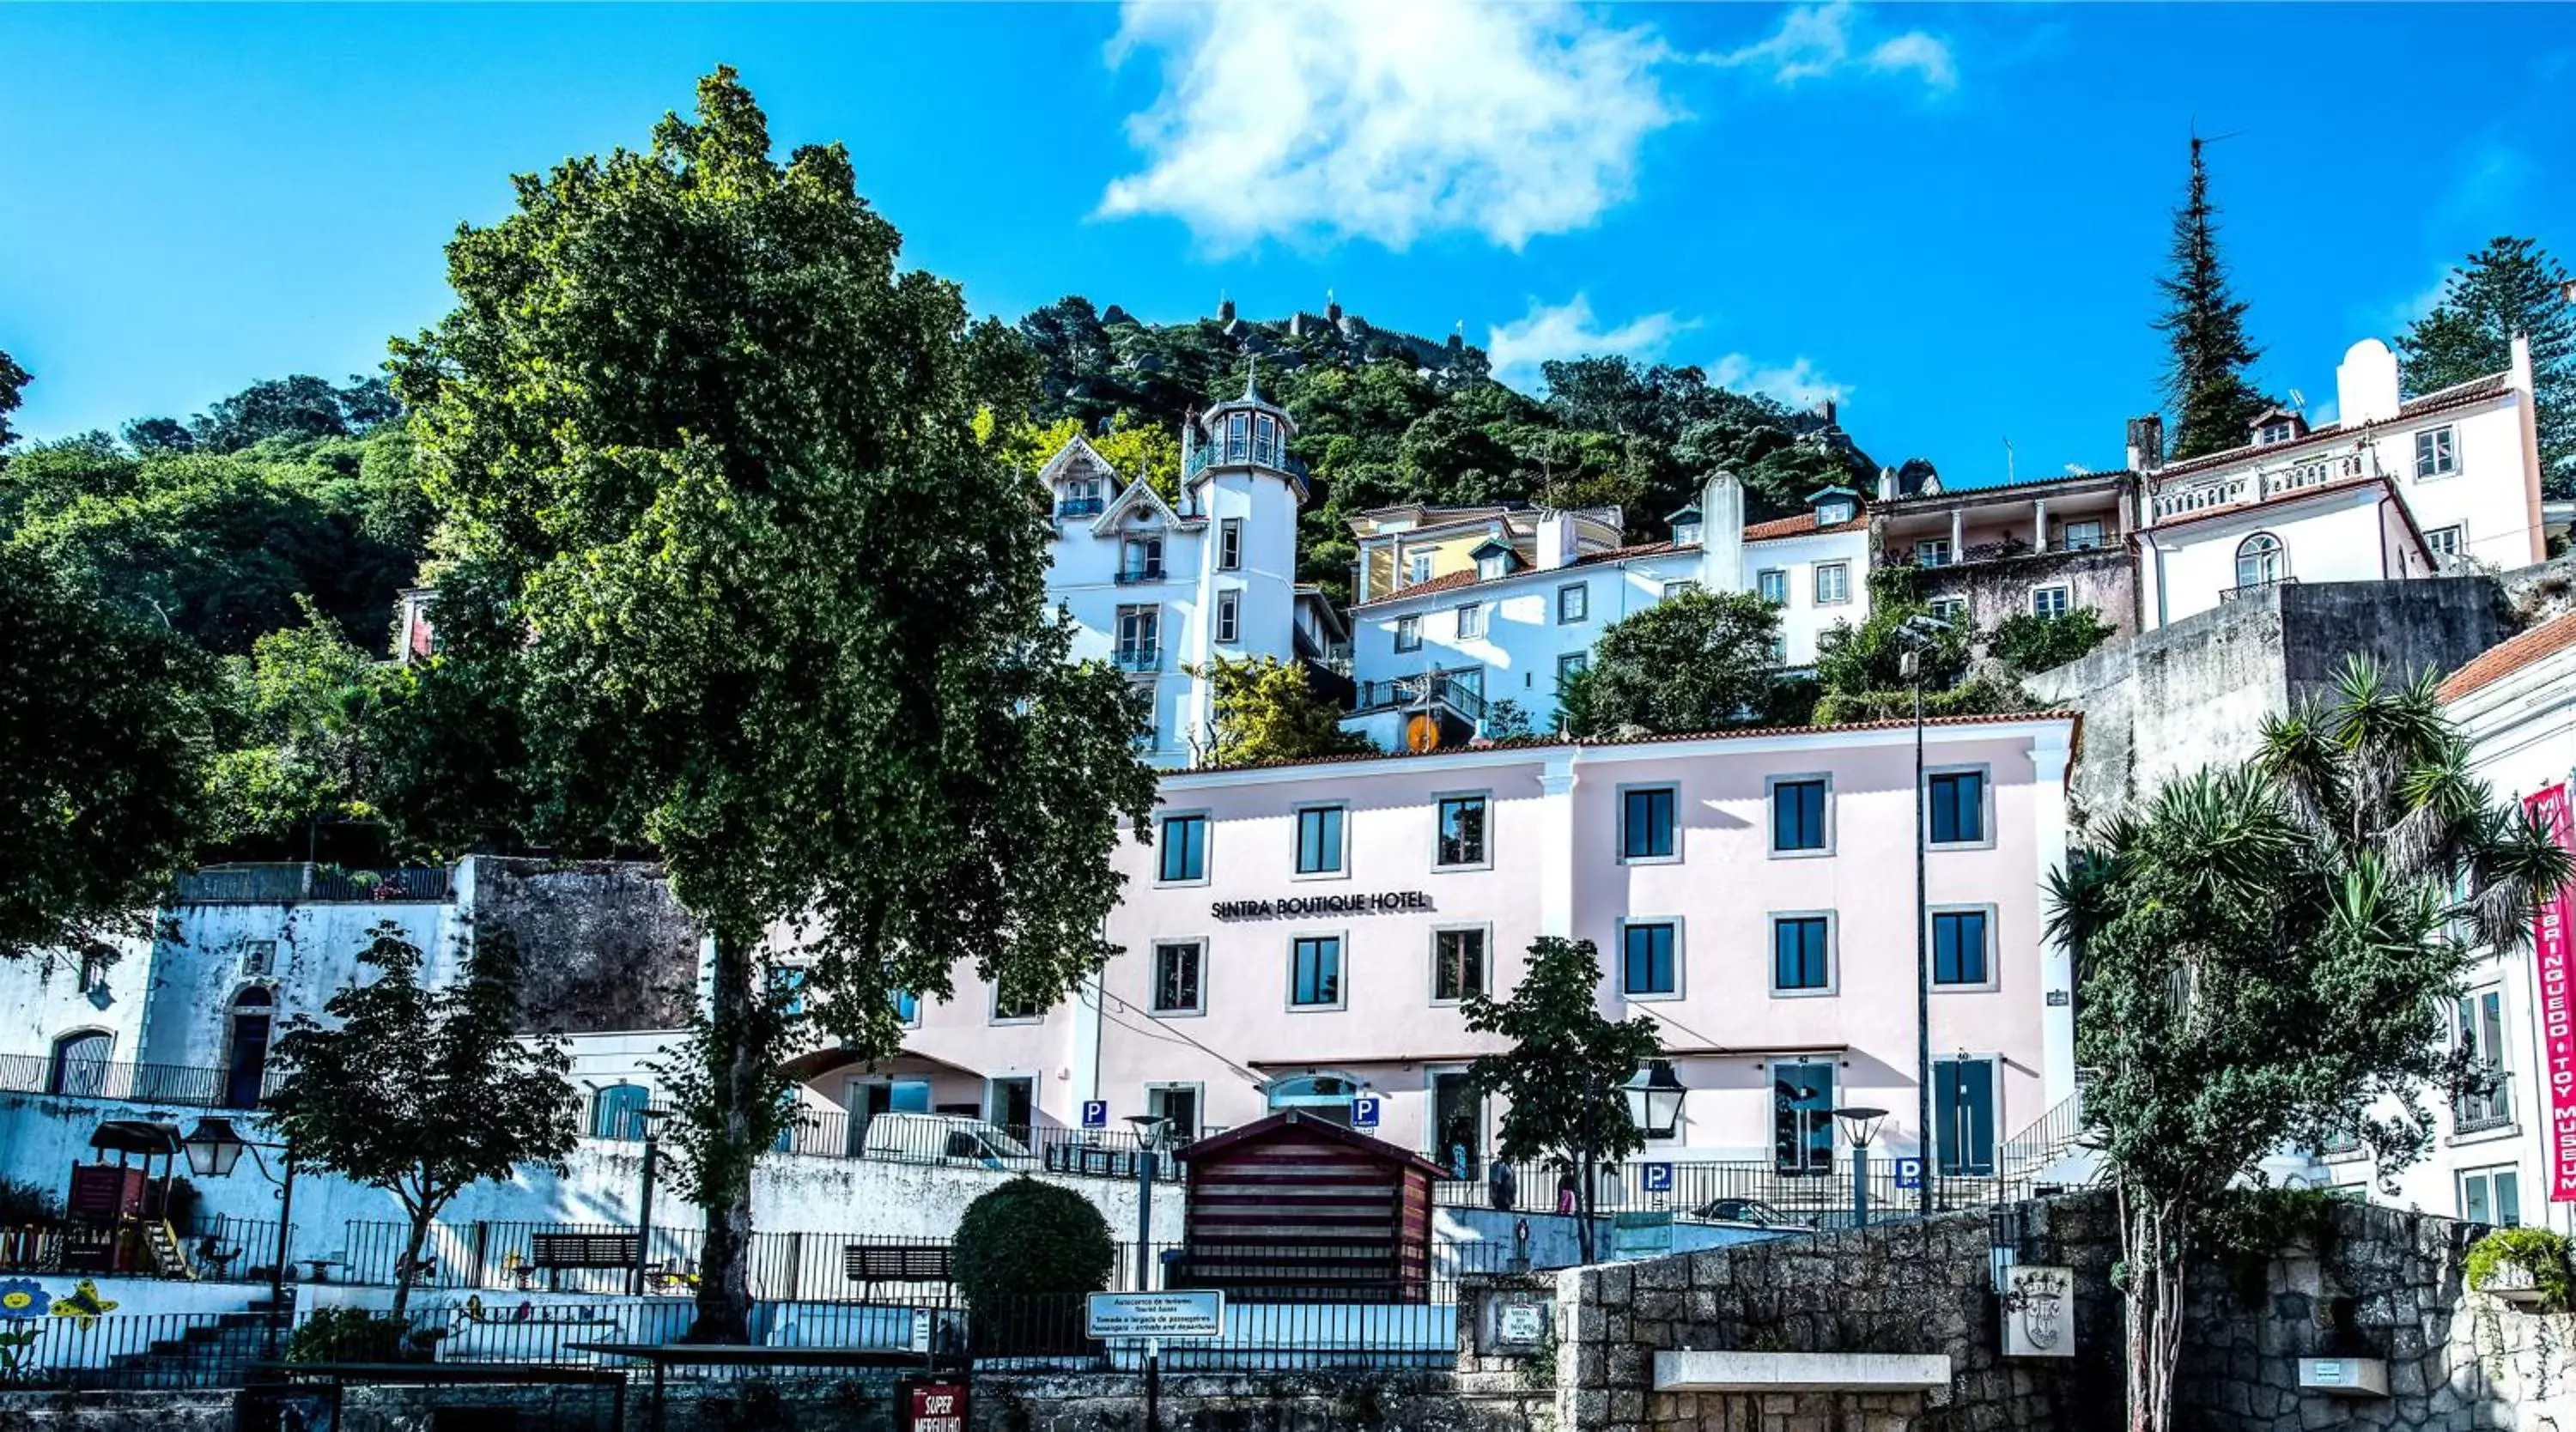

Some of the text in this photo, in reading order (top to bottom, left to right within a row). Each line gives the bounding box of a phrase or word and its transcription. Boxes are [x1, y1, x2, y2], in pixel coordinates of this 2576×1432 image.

[1212, 890, 1426, 919] SINTRA BOUTIQUE HOTEL
[2543, 913, 2569, 1038] BRINQUEDO
[2553, 1058, 2573, 1098] TOY
[1088, 1103, 1102, 1122] P
[1358, 1100, 1373, 1120] P
[2555, 1107, 2576, 1190] MUSEUM
[1648, 1166, 1667, 1189] P
[1900, 1161, 1921, 1186] P
[925, 1395, 954, 1416] SUPER
